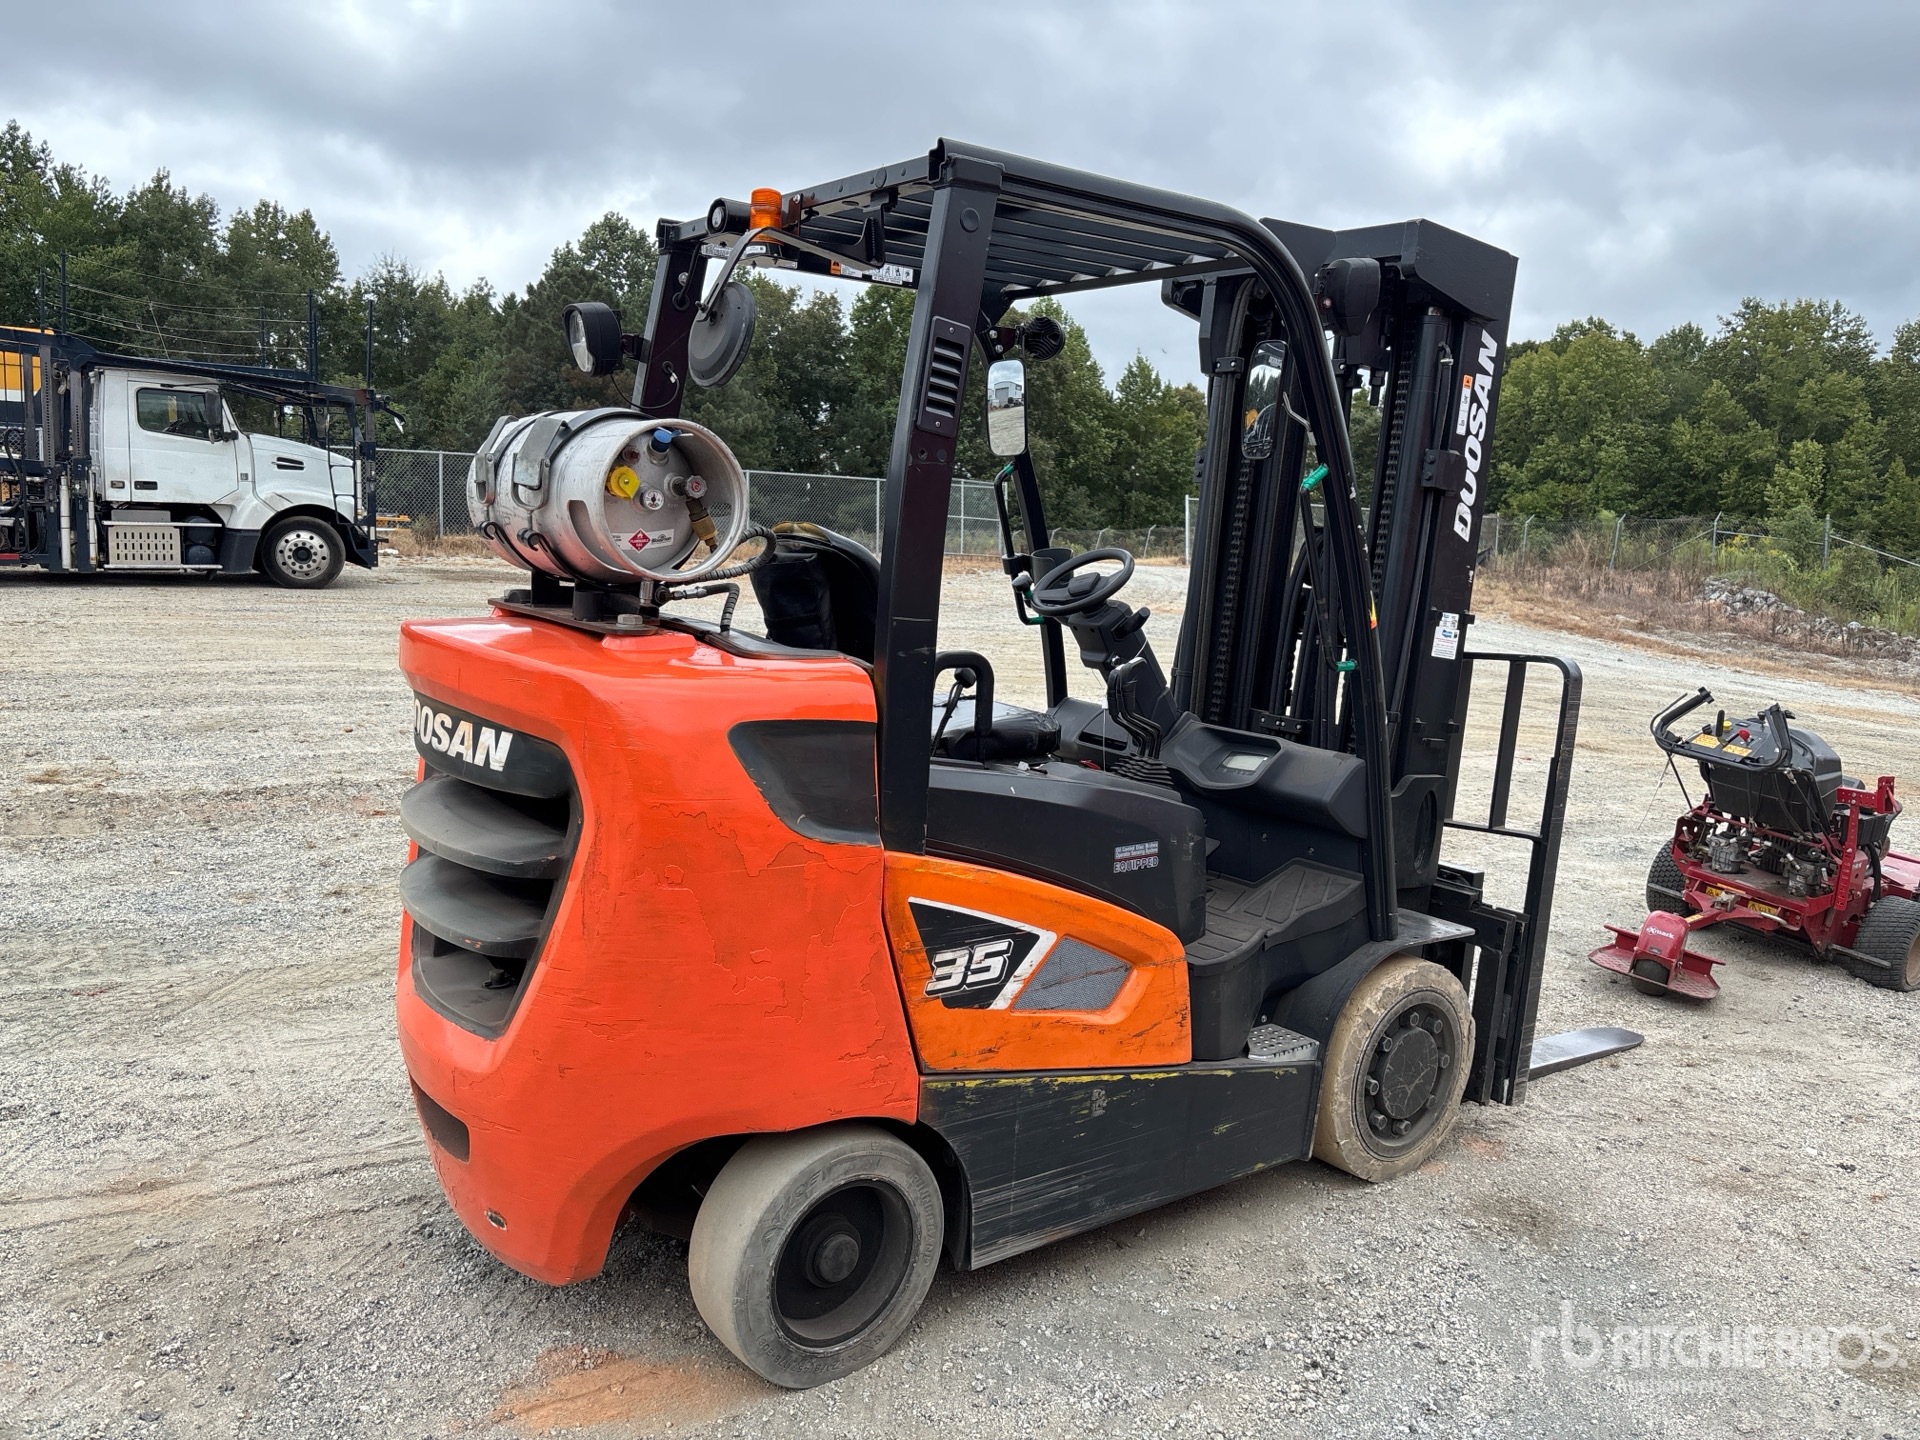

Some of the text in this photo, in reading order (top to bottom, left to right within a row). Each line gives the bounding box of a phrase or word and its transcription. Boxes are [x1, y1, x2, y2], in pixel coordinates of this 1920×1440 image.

[1453, 328, 1498, 543] DOOSAN
[1113, 855, 1159, 873] EQUIPPED
[924, 939, 1014, 997] 35
